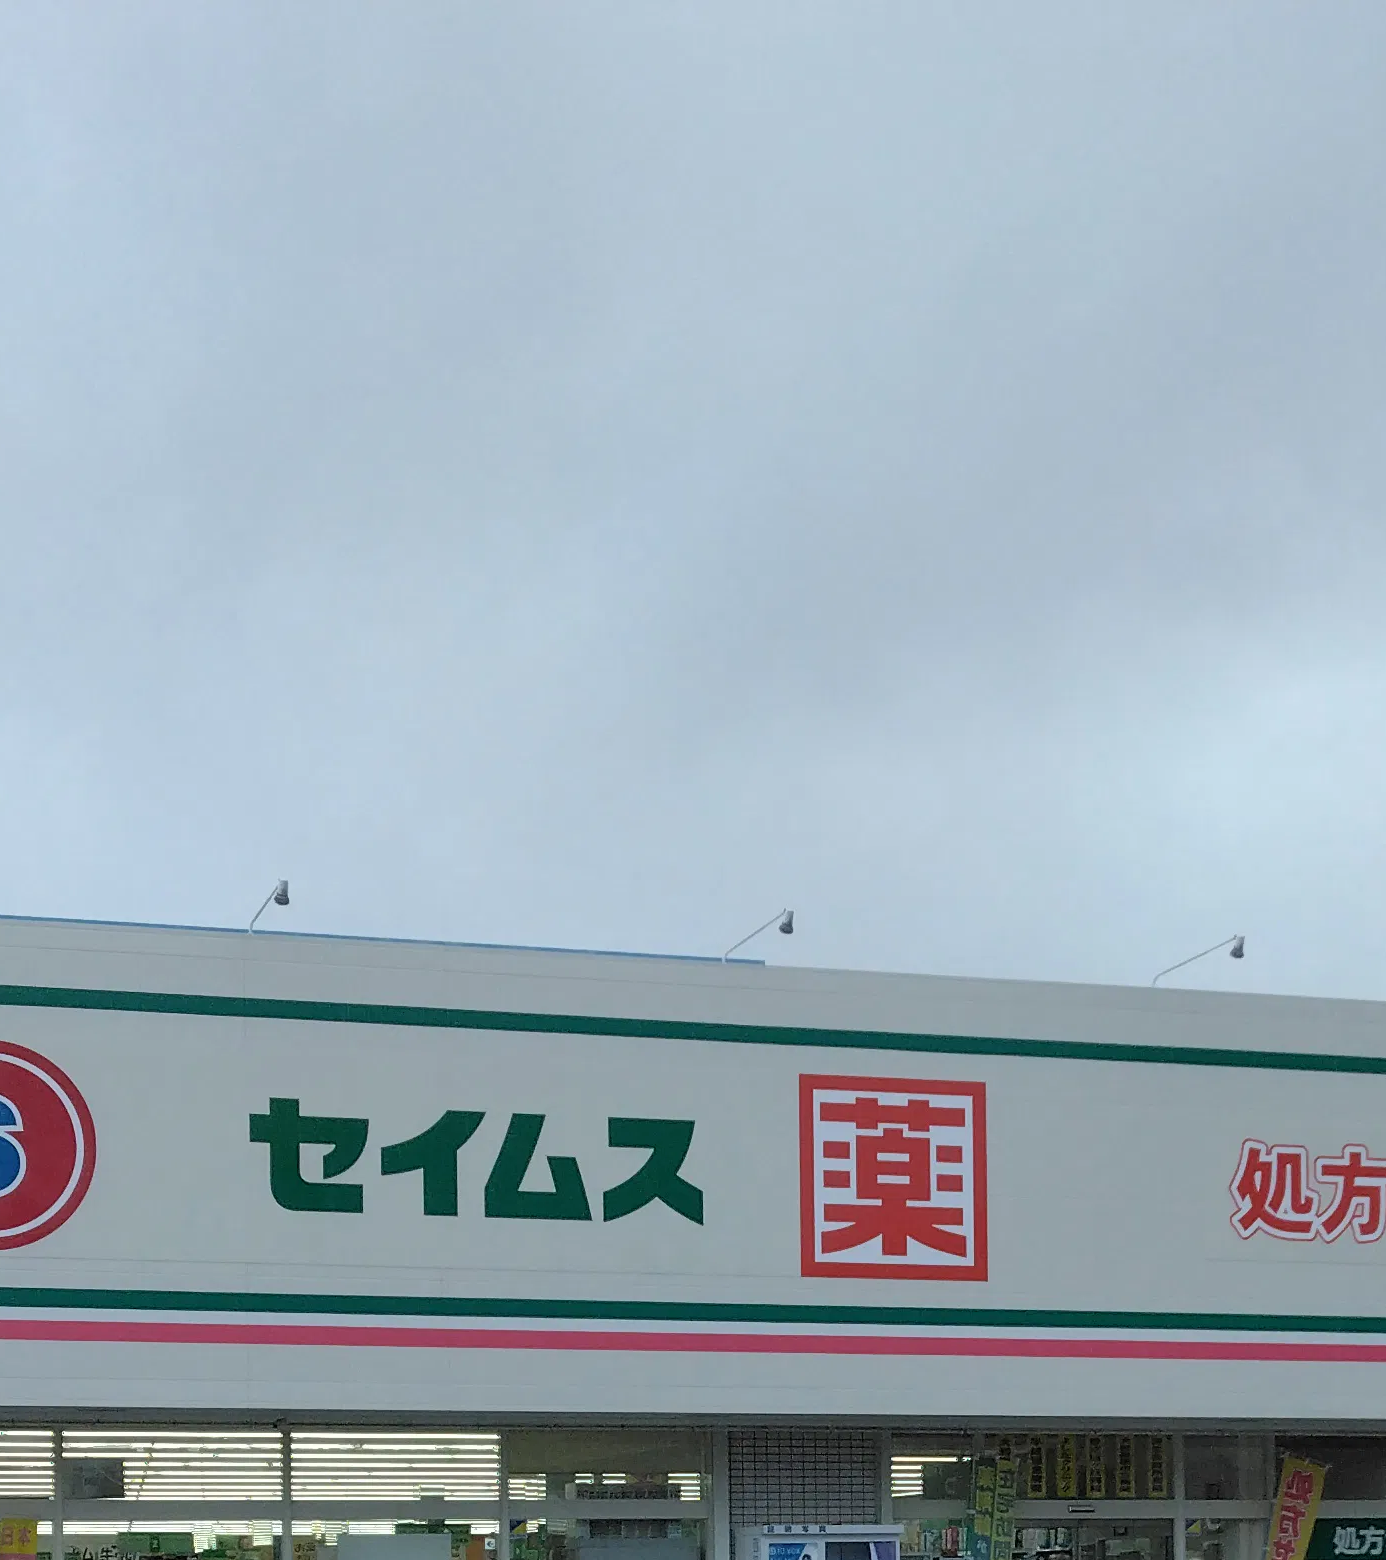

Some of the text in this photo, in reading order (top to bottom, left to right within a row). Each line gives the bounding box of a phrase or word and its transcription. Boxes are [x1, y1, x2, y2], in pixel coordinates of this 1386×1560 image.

[248, 1096, 703, 1225] セイムス
[818, 1096, 967, 1257] 薬
